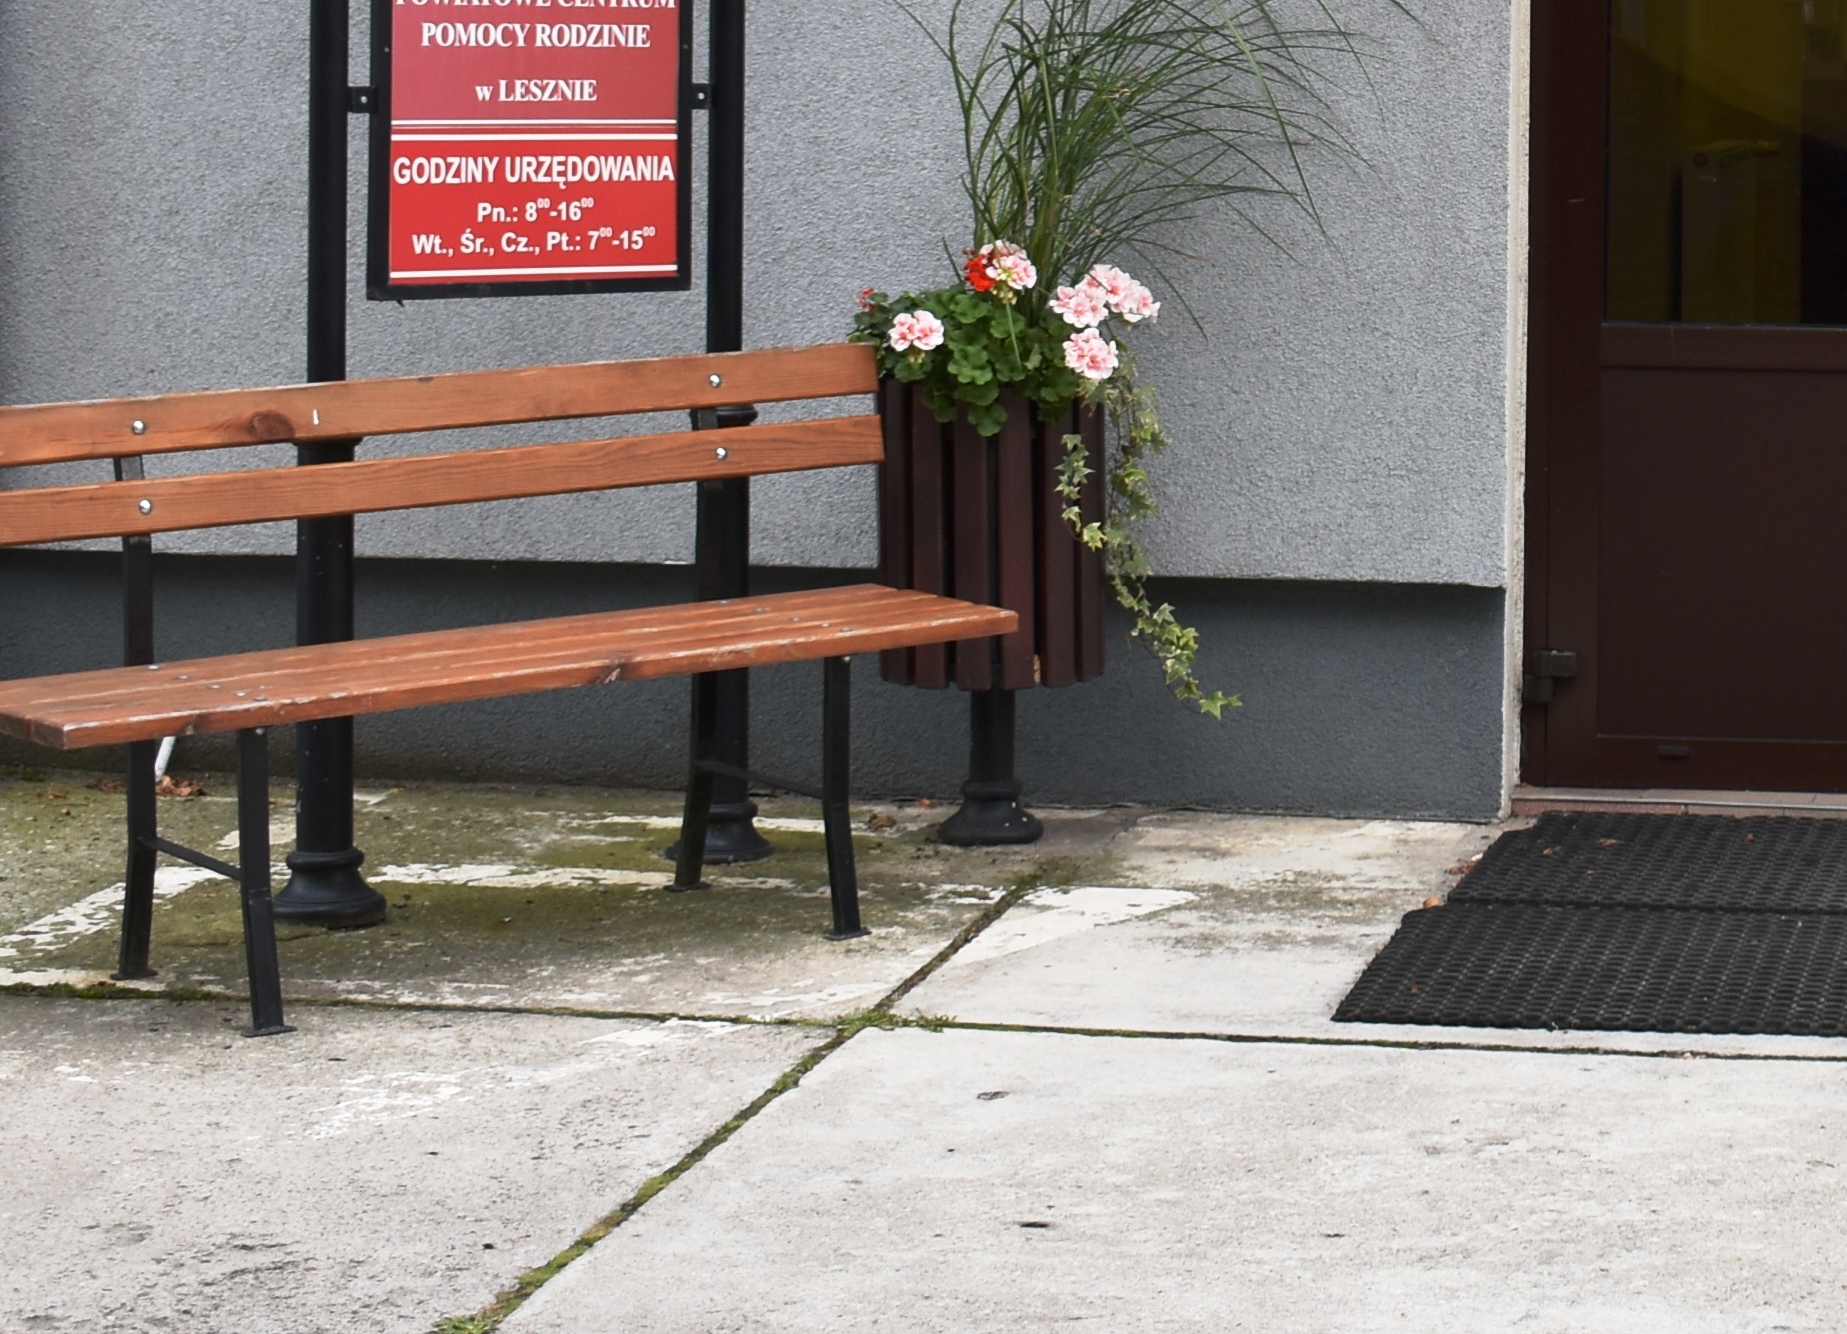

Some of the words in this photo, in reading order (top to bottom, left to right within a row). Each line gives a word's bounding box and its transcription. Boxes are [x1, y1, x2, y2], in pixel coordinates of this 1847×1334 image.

[421, 22, 530, 48] POMOCY
[535, 24, 651, 48] RODZINIE
[475, 84, 493, 101] w
[498, 78, 597, 102] LESZNIE
[393, 155, 499, 185] GODZINY
[505, 154, 675, 189] URZĘDOWANIA
[477, 201, 518, 222] Pn.:
[413, 234, 453, 255] Wt.,
[460, 229, 494, 255] Śr.,
[501, 231, 539, 254] Cz.,
[547, 232, 583, 253] Pt.:
